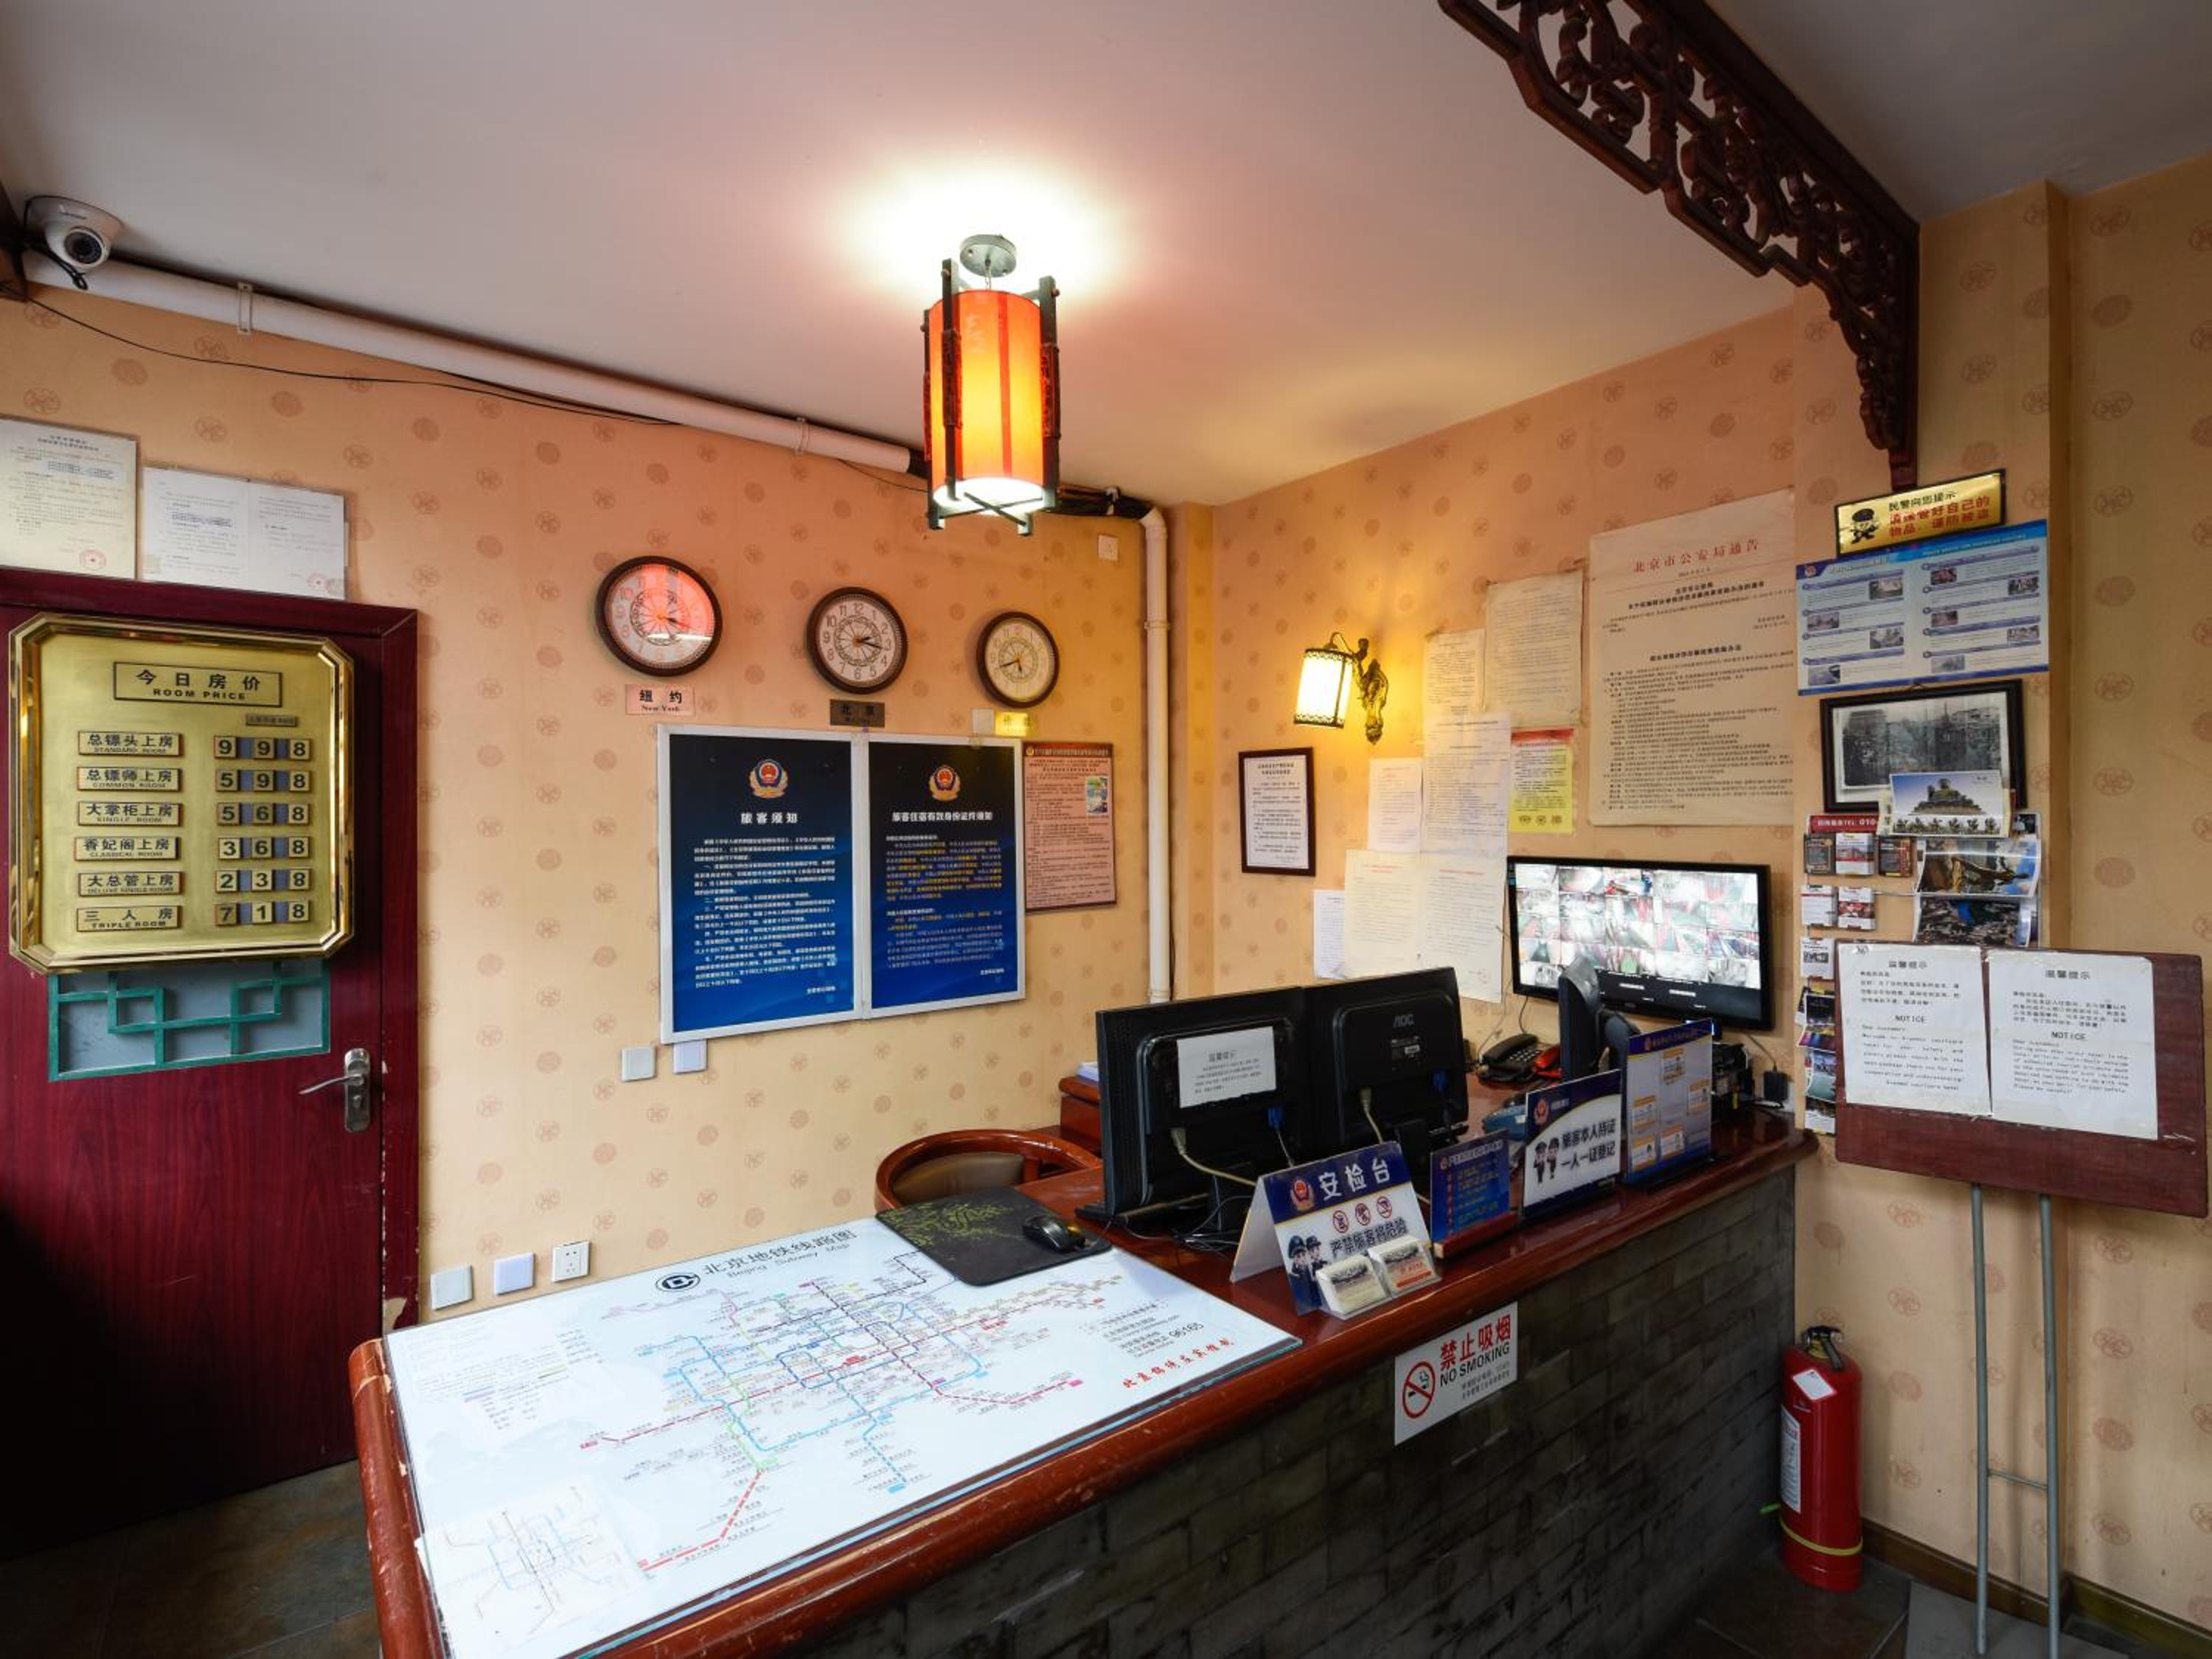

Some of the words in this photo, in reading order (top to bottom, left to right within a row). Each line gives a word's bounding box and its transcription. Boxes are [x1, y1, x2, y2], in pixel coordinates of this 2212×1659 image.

[136, 669, 260, 691] 今日房价
[153, 688, 195, 698] ROOM
[204, 691, 246, 700] PRICE
[639, 689, 682, 703] 纽约
[218, 740, 306, 757] 998
[220, 773, 306, 788] 598
[222, 806, 305, 821] 568
[741, 812, 798, 824] 旅客须知
[223, 839, 305, 856] 368
[220, 872, 306, 888] 238
[84, 908, 173, 922] 三人房
[220, 903, 305, 922] 718
[1894, 1015, 1927, 1023] NOTICE
[2051, 1031, 2086, 1040] NOTICE
[1561, 1141, 1615, 1169] 一人一证登记
[1318, 1158, 1391, 1200] 安检台
[1440, 1314, 1512, 1371] 禁止吸烟
[1440, 1368, 1456, 1387] NO
[1459, 1342, 1510, 1377] SMOKING
